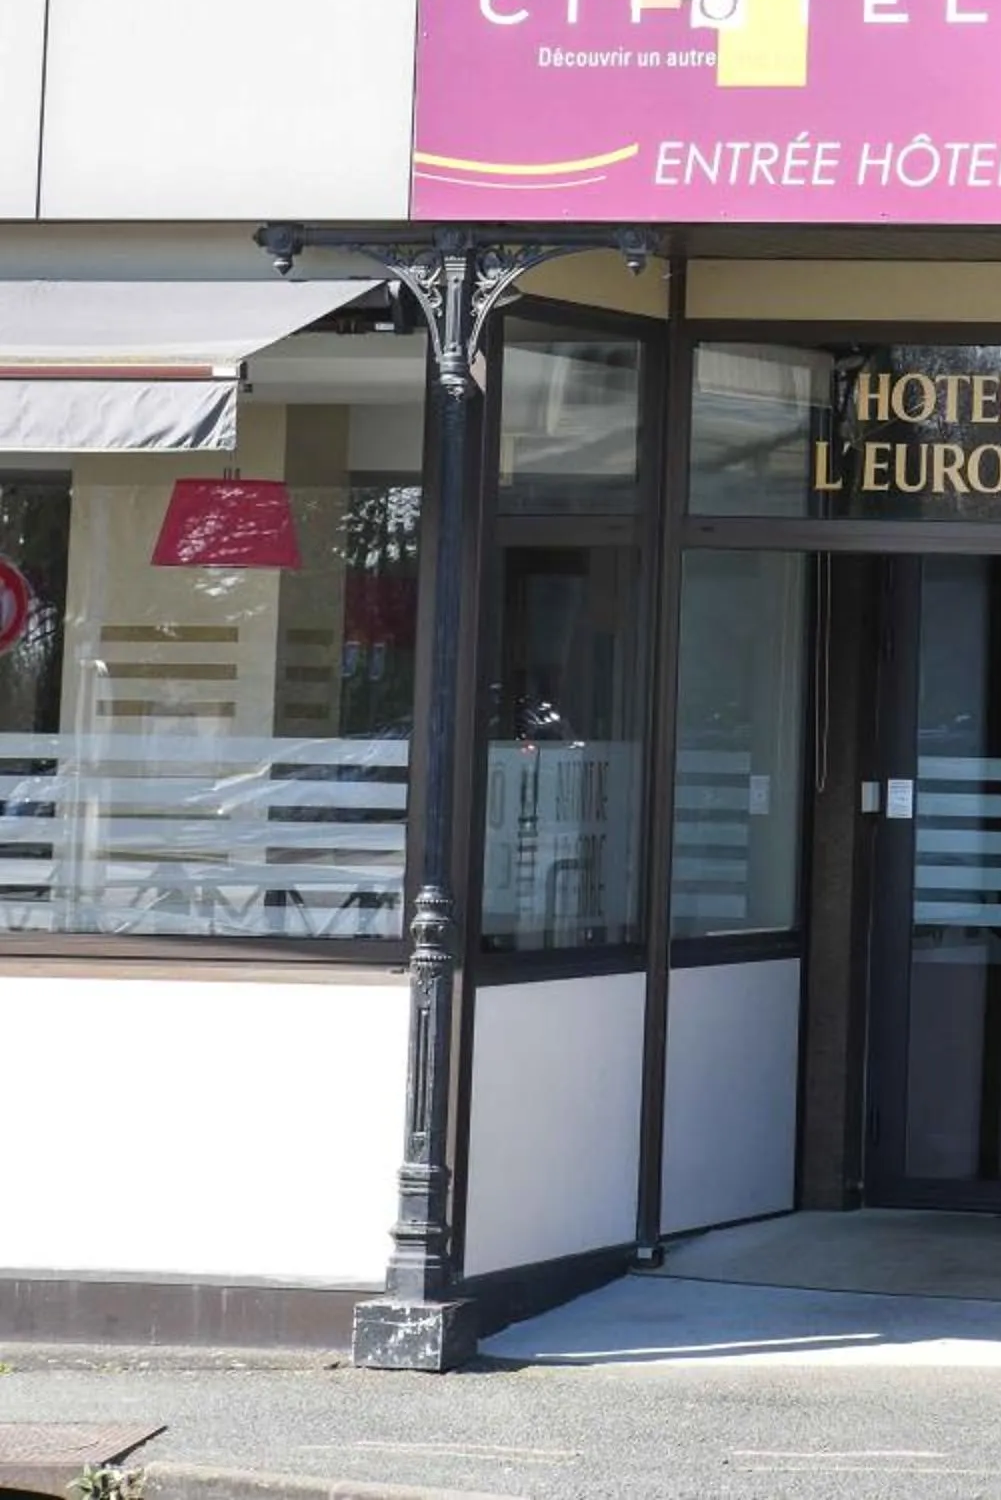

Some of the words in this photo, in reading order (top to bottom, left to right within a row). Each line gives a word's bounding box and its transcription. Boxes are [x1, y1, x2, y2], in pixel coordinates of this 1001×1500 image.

[538, 47, 630, 67] Découvrir
[637, 54, 660, 67] un
[666, 49, 716, 67] autre
[655, 131, 841, 187] ENTRÉE
